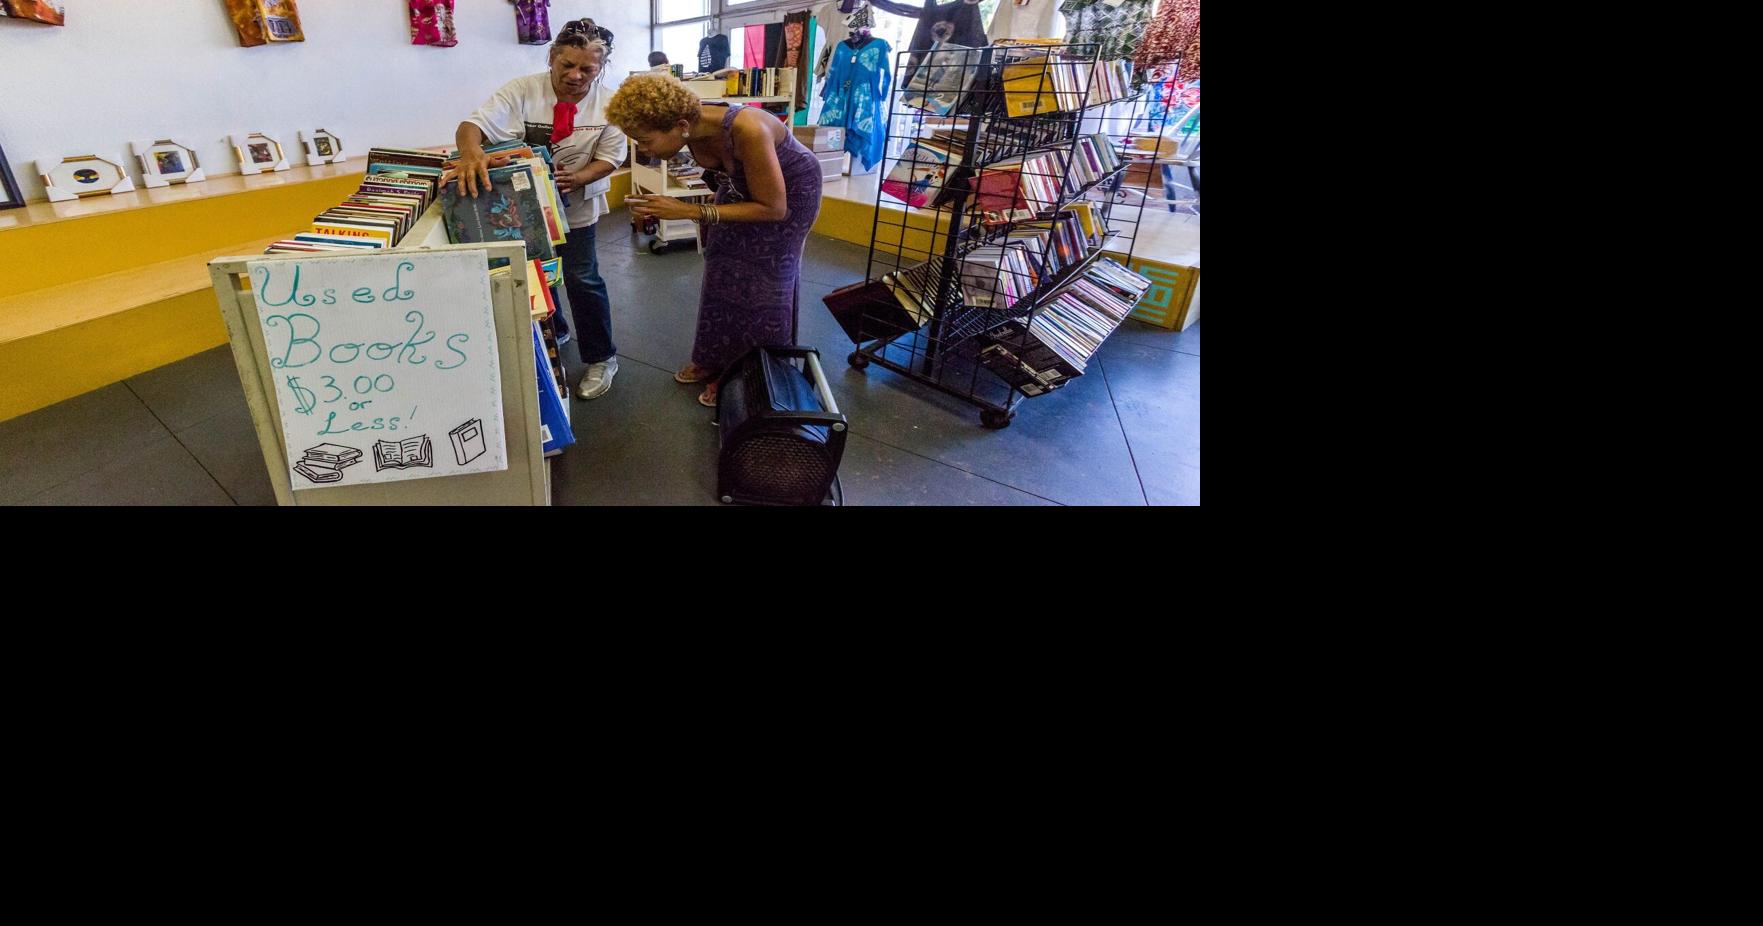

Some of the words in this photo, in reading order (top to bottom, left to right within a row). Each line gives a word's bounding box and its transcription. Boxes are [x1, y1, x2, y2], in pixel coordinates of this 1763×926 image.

[254, 261, 416, 307] Used
[266, 310, 470, 370] Books
[286, 373, 395, 416] $3.00
[349, 399, 372, 412] or
[316, 405, 418, 436] Less!
